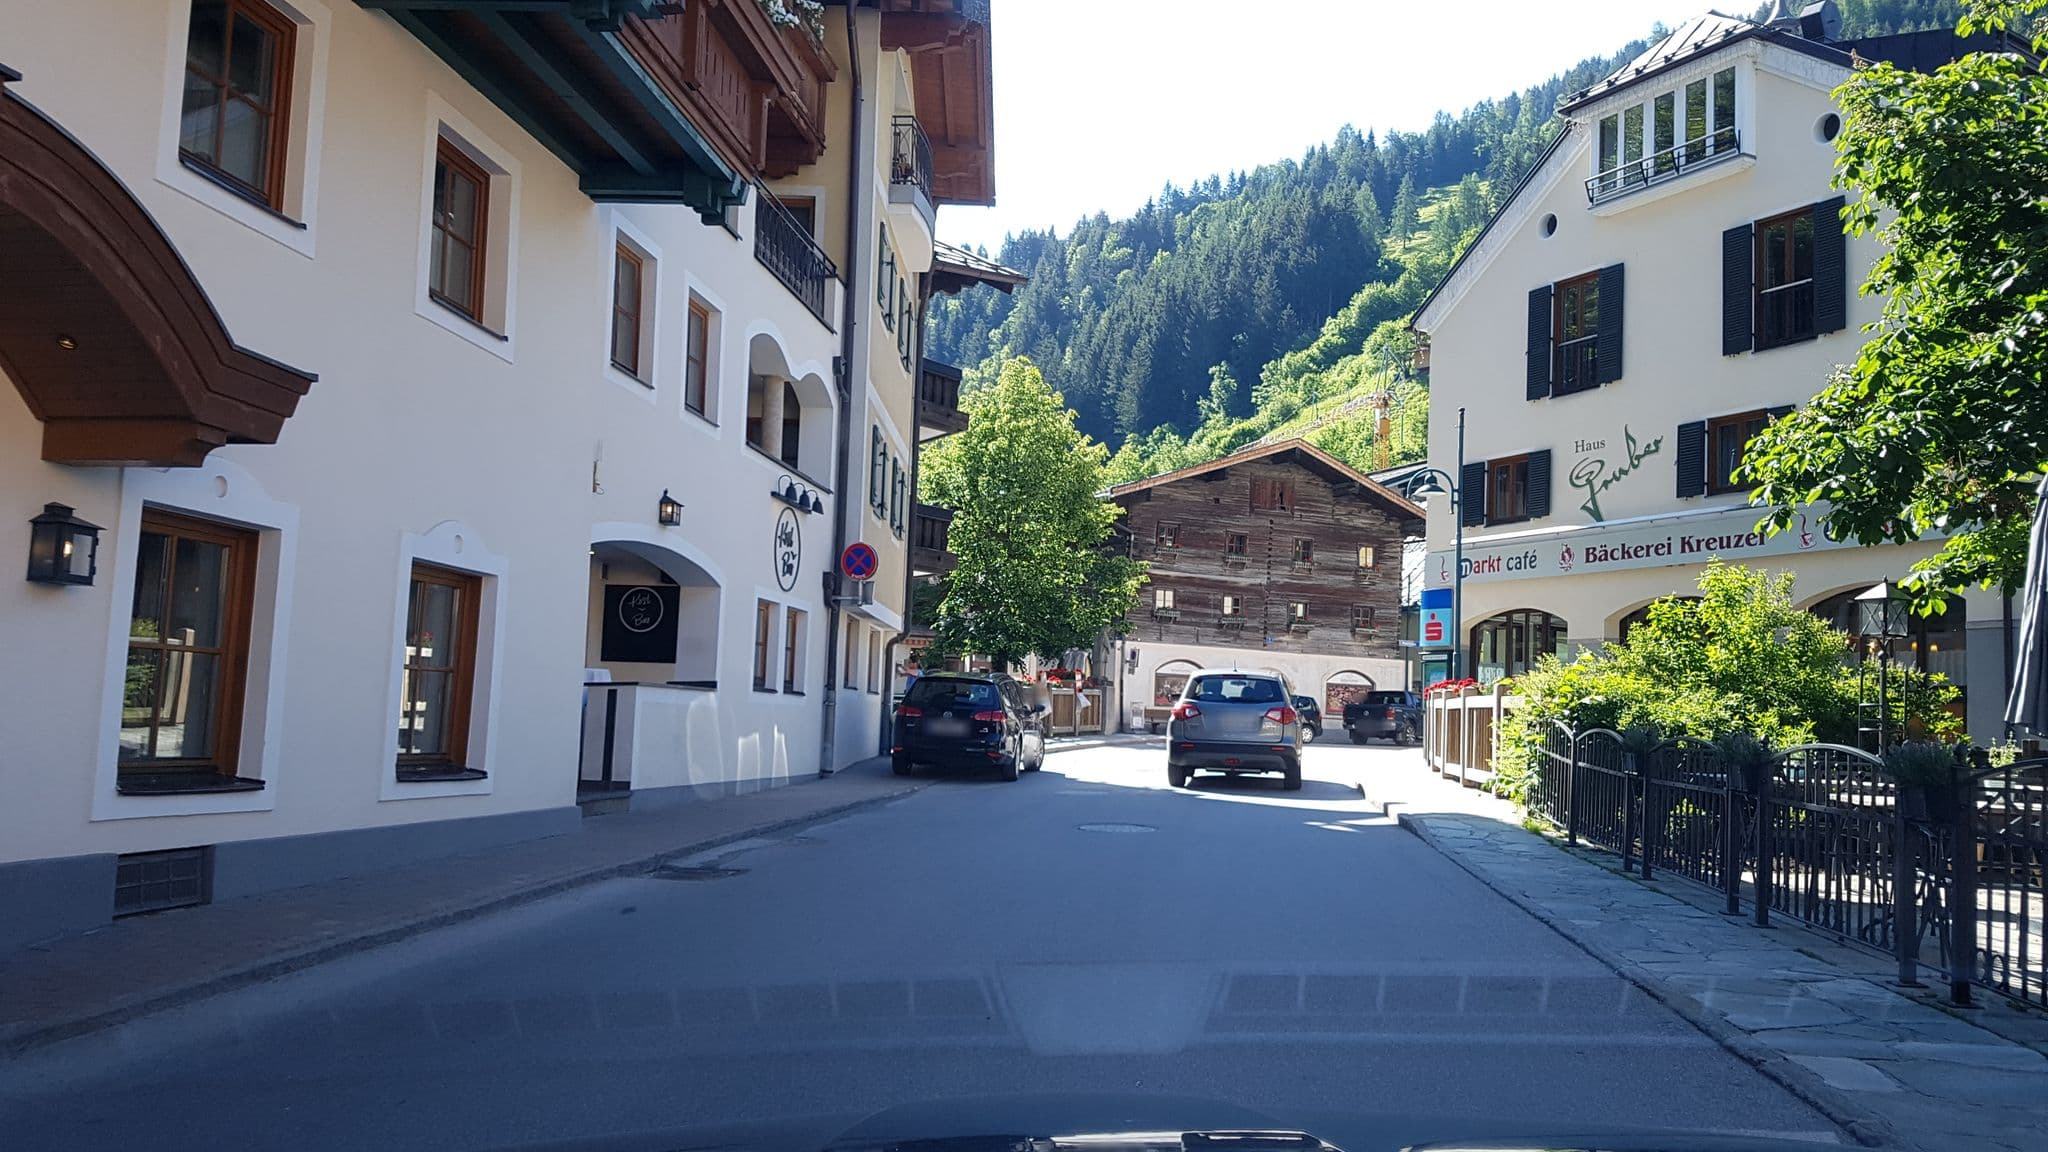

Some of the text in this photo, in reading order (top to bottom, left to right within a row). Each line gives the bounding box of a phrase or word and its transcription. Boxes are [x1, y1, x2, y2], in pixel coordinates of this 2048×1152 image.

[1574, 439, 1607, 454] Haus
[1506, 549, 1538, 572] café
[1584, 536, 1673, 564] Bäckerei
